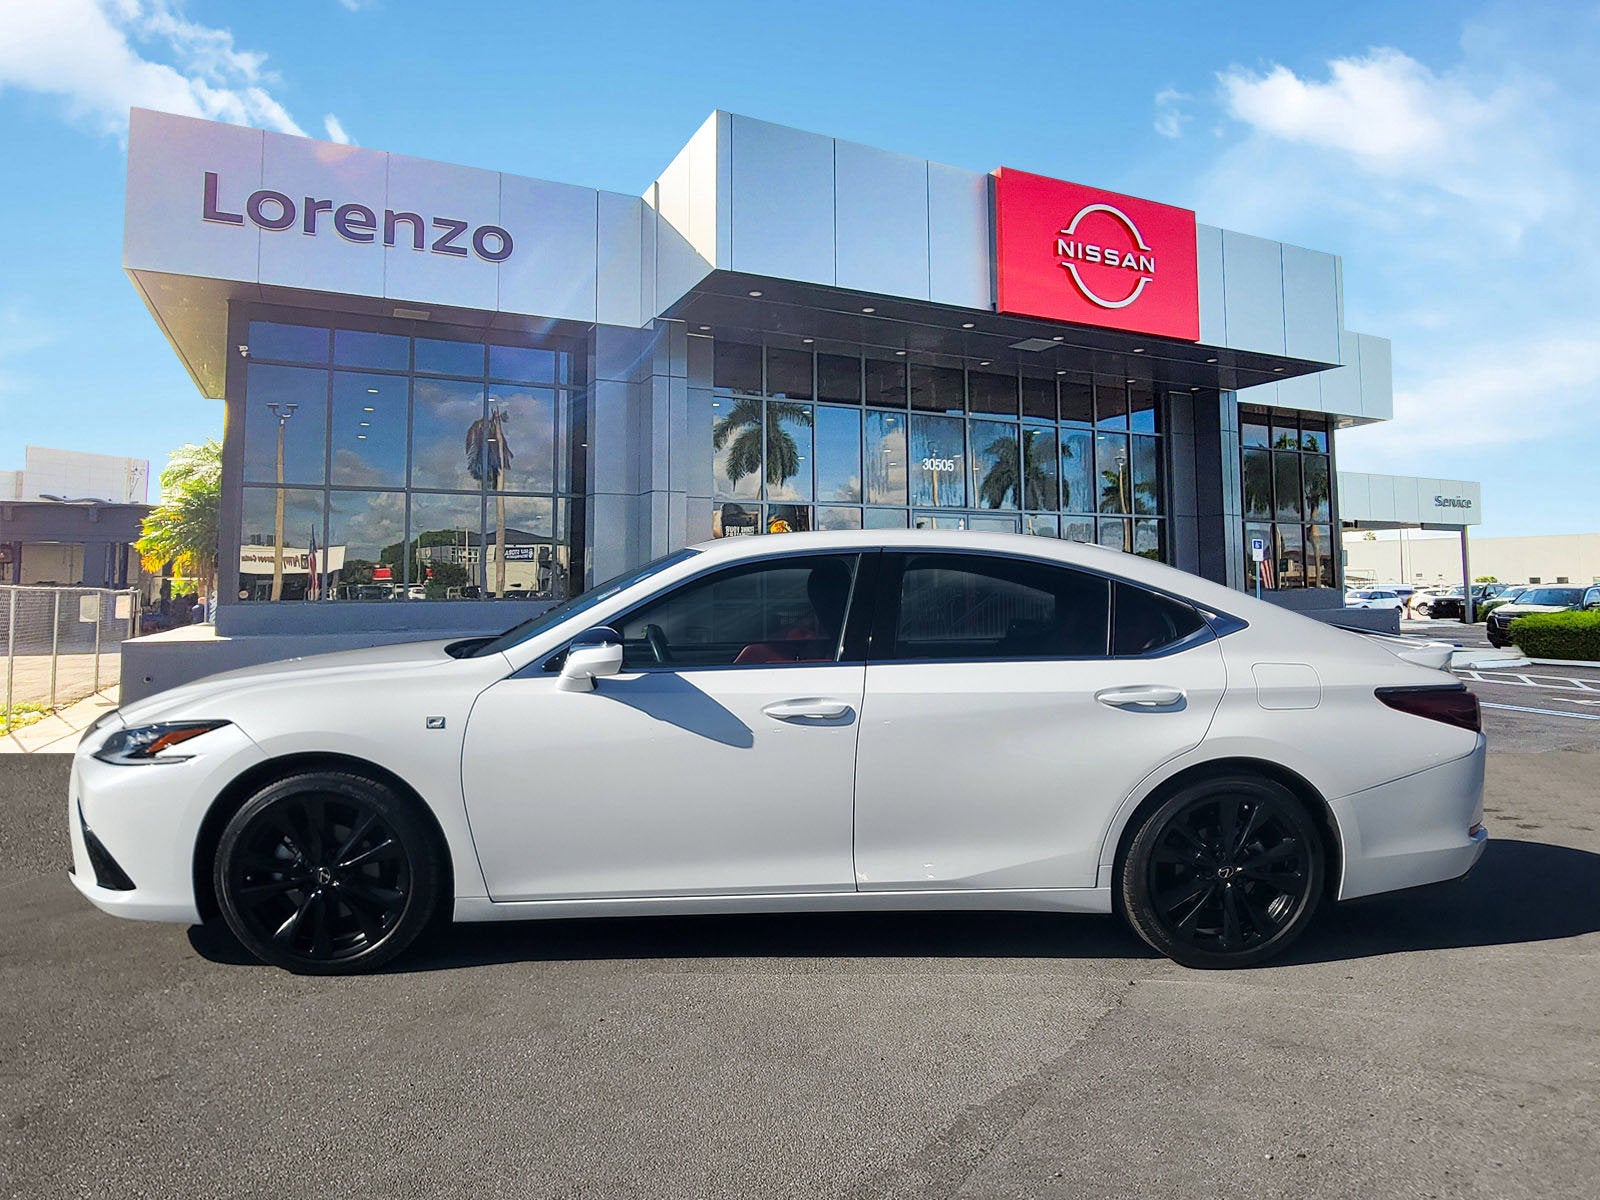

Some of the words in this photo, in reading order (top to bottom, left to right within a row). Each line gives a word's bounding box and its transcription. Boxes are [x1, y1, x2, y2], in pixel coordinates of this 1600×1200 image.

[202, 171, 514, 262] Lorenzo
[1057, 238, 1155, 273] NISSAN
[922, 457, 955, 472] 30505
[1434, 495, 1472, 508] Service
